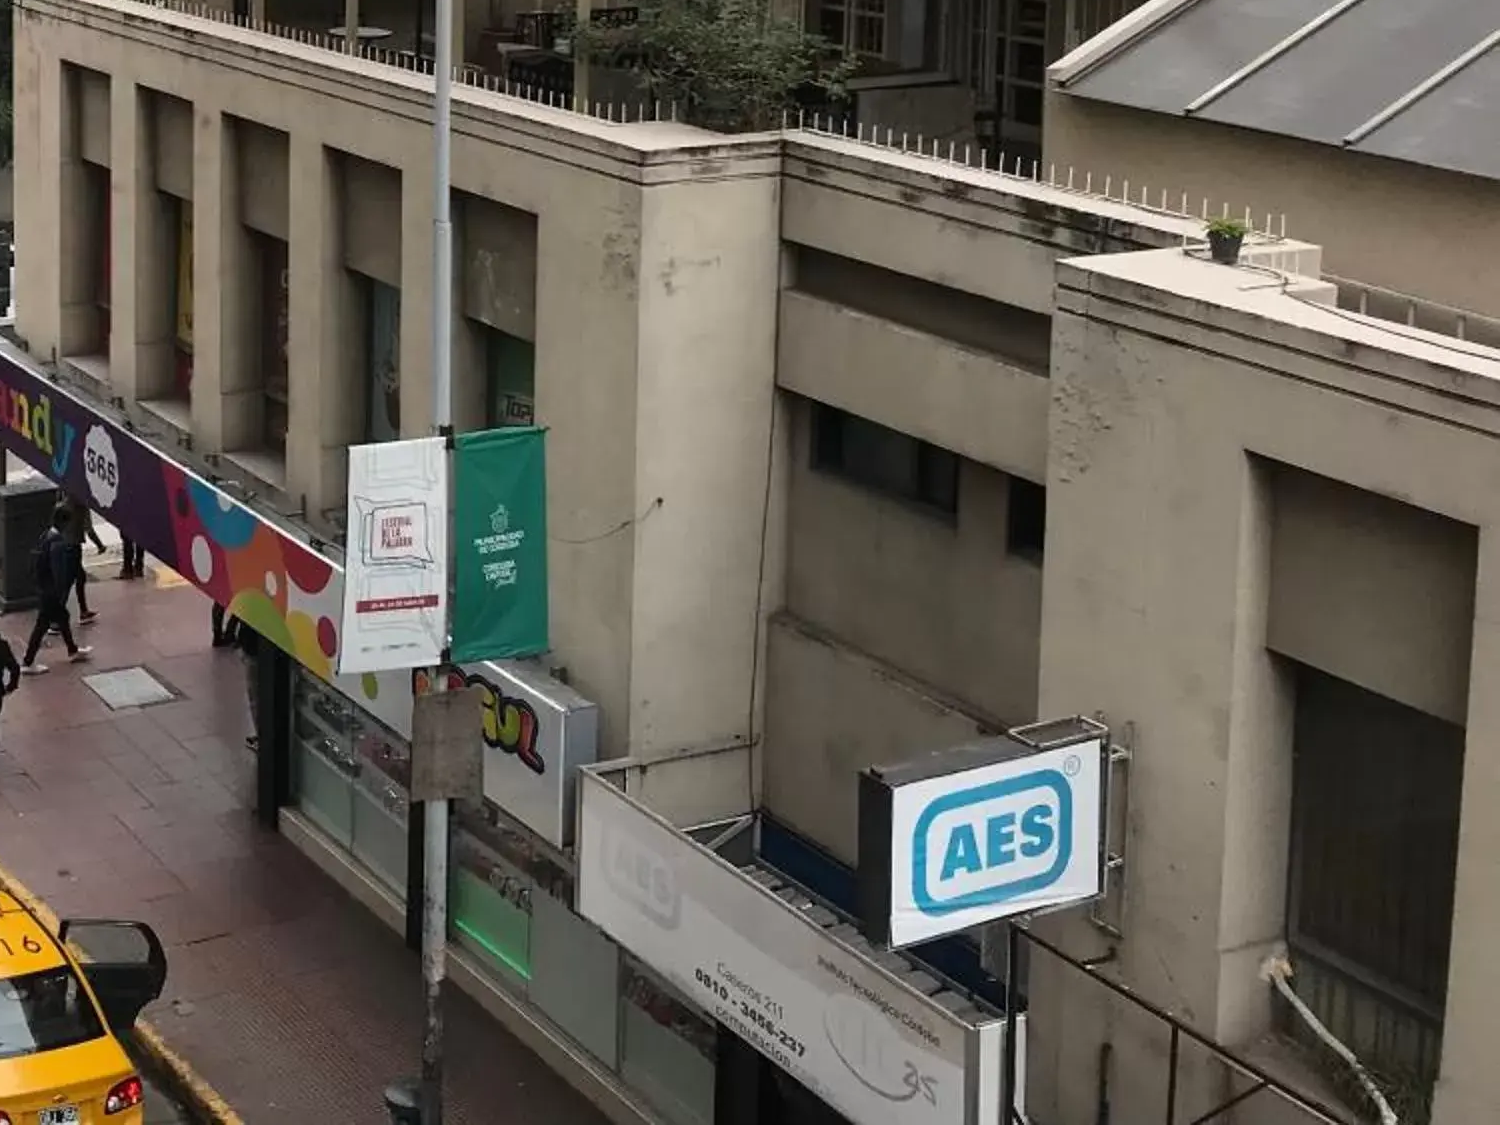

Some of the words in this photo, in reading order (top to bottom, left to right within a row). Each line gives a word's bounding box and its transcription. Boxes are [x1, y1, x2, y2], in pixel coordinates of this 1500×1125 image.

[86, 449, 116, 488] 365
[939, 804, 1053, 882] AES
[695, 967, 729, 1001] 0810
[764, 995, 784, 1020] 211
